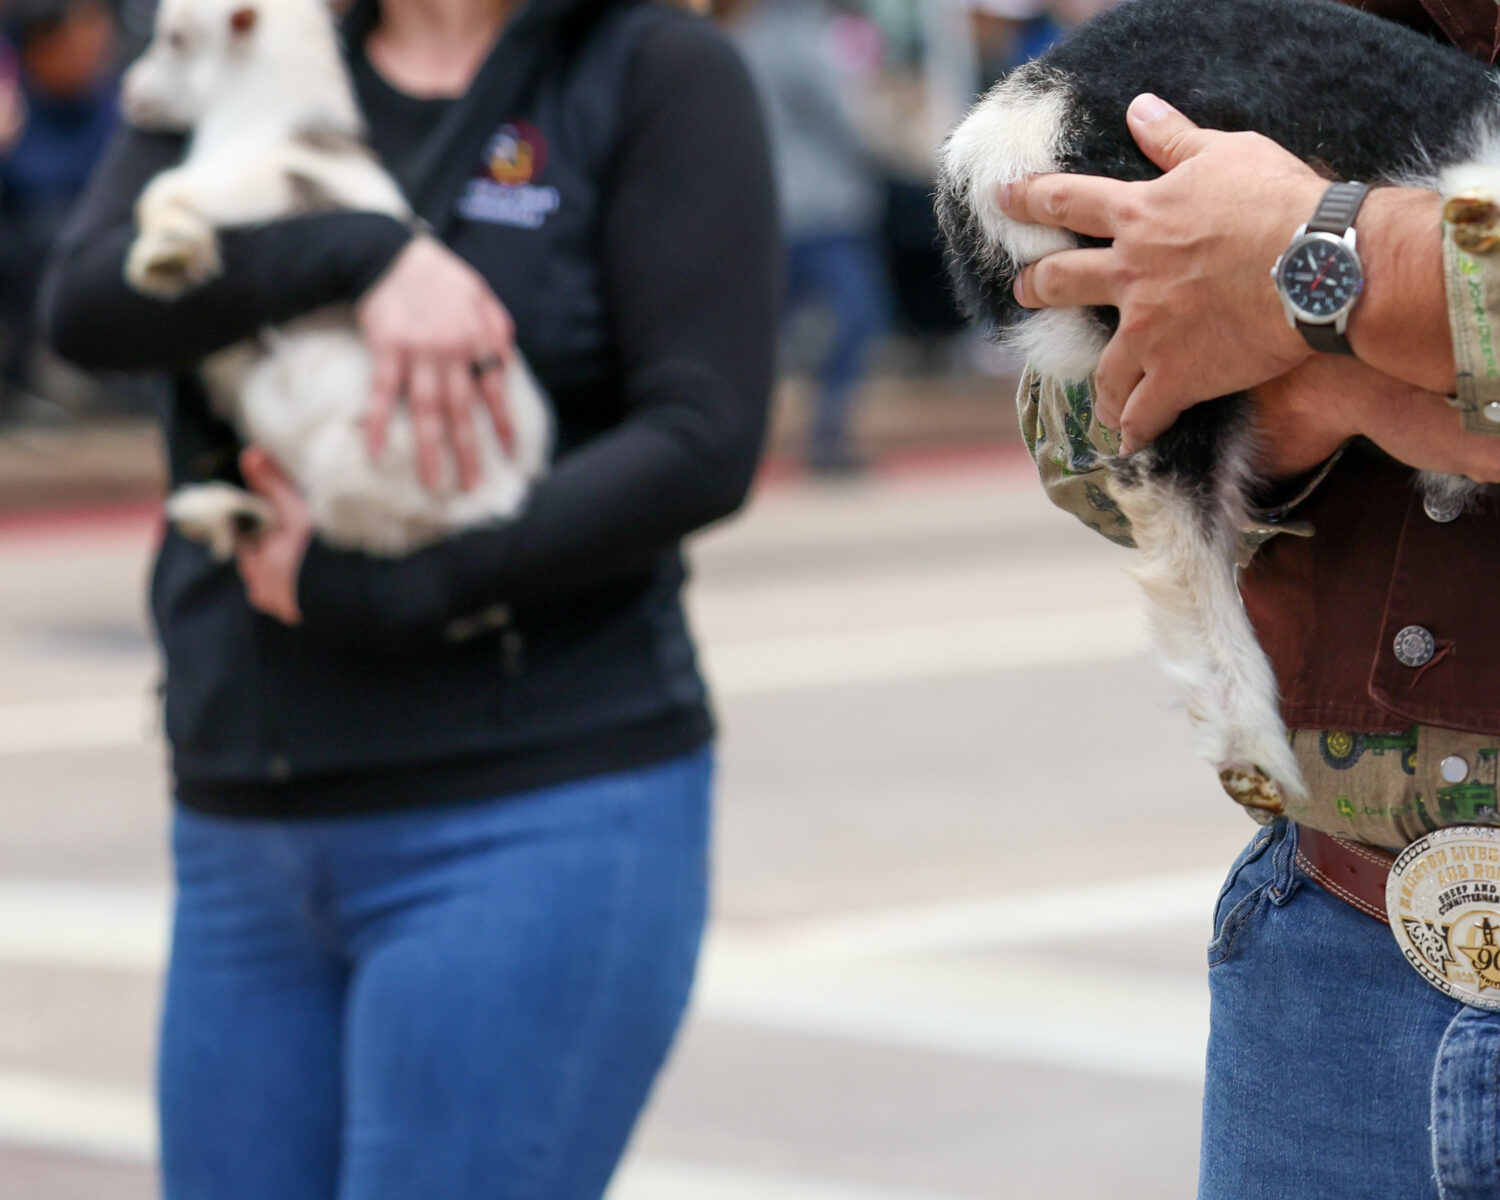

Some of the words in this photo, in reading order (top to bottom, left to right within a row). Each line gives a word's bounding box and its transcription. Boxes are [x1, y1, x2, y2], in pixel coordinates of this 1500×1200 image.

[1400, 850, 1447, 911] HOUSTON
[1437, 864, 1469, 886] AND
[1438, 885, 1468, 905] SHEEP
[1474, 883, 1497, 894] AND
